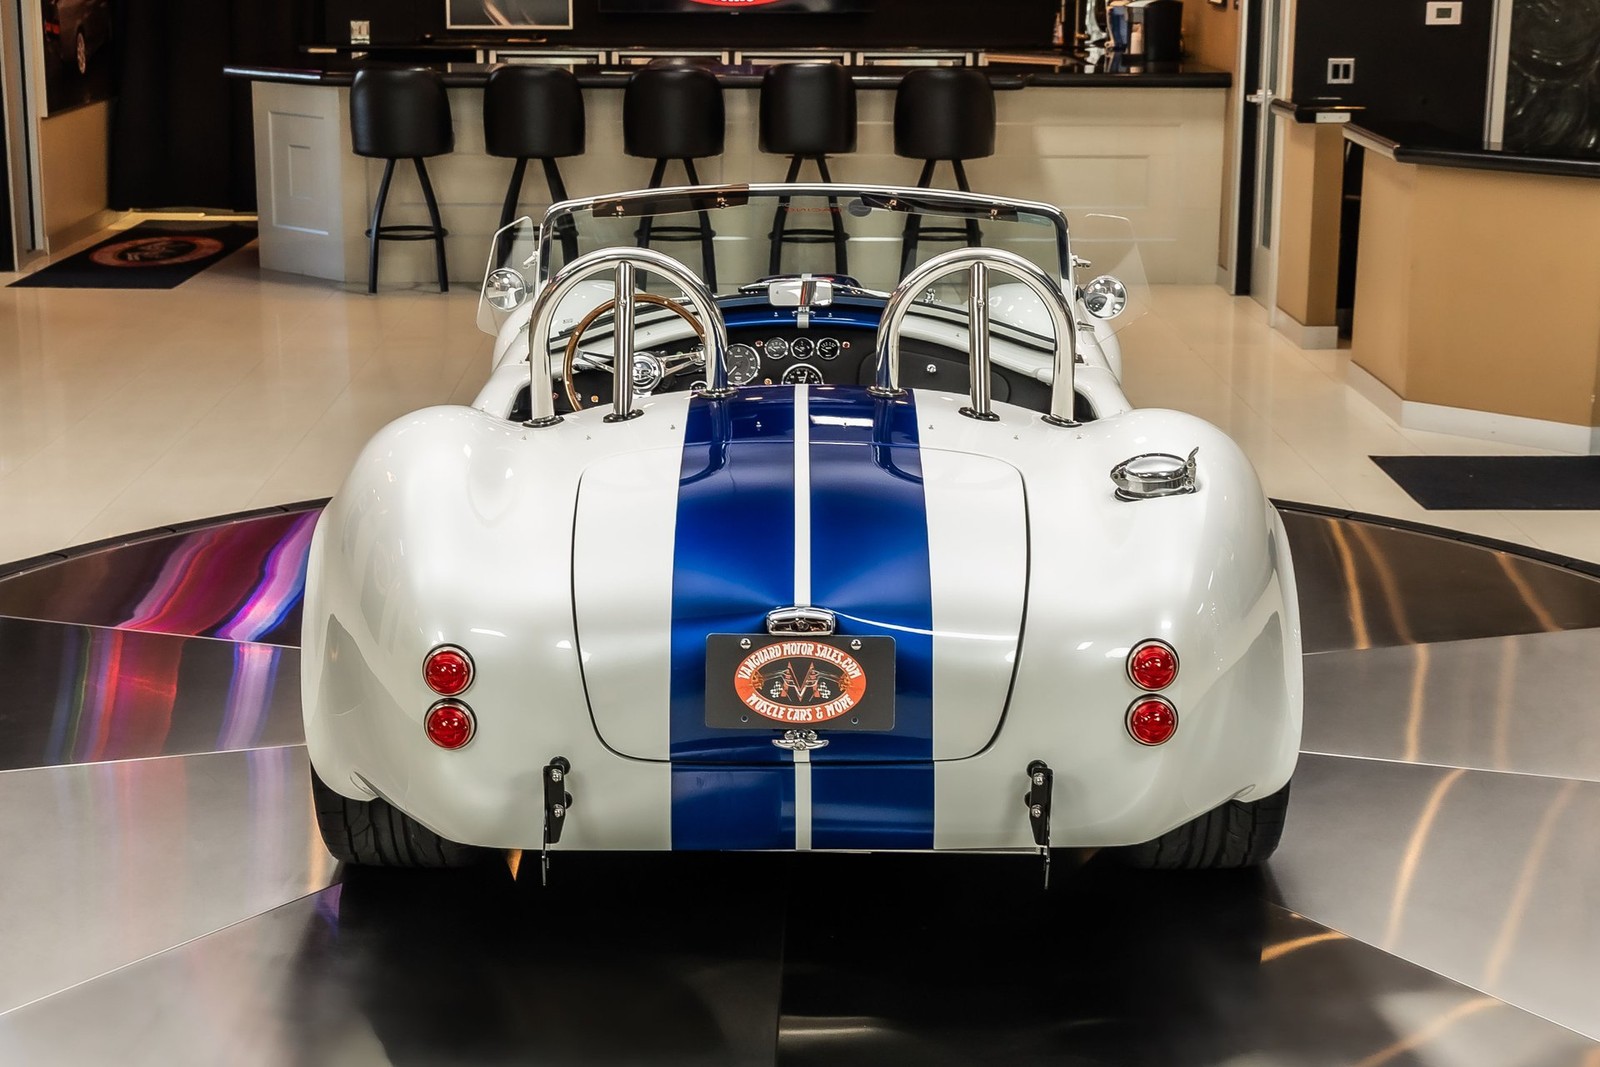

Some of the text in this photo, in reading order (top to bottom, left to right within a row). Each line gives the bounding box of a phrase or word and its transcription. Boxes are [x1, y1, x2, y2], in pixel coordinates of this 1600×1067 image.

[738, 646, 782, 679] VANGUARD
[782, 643, 814, 656] MOTOR
[746, 693, 855, 721] MUSCLE CARS & MORE
